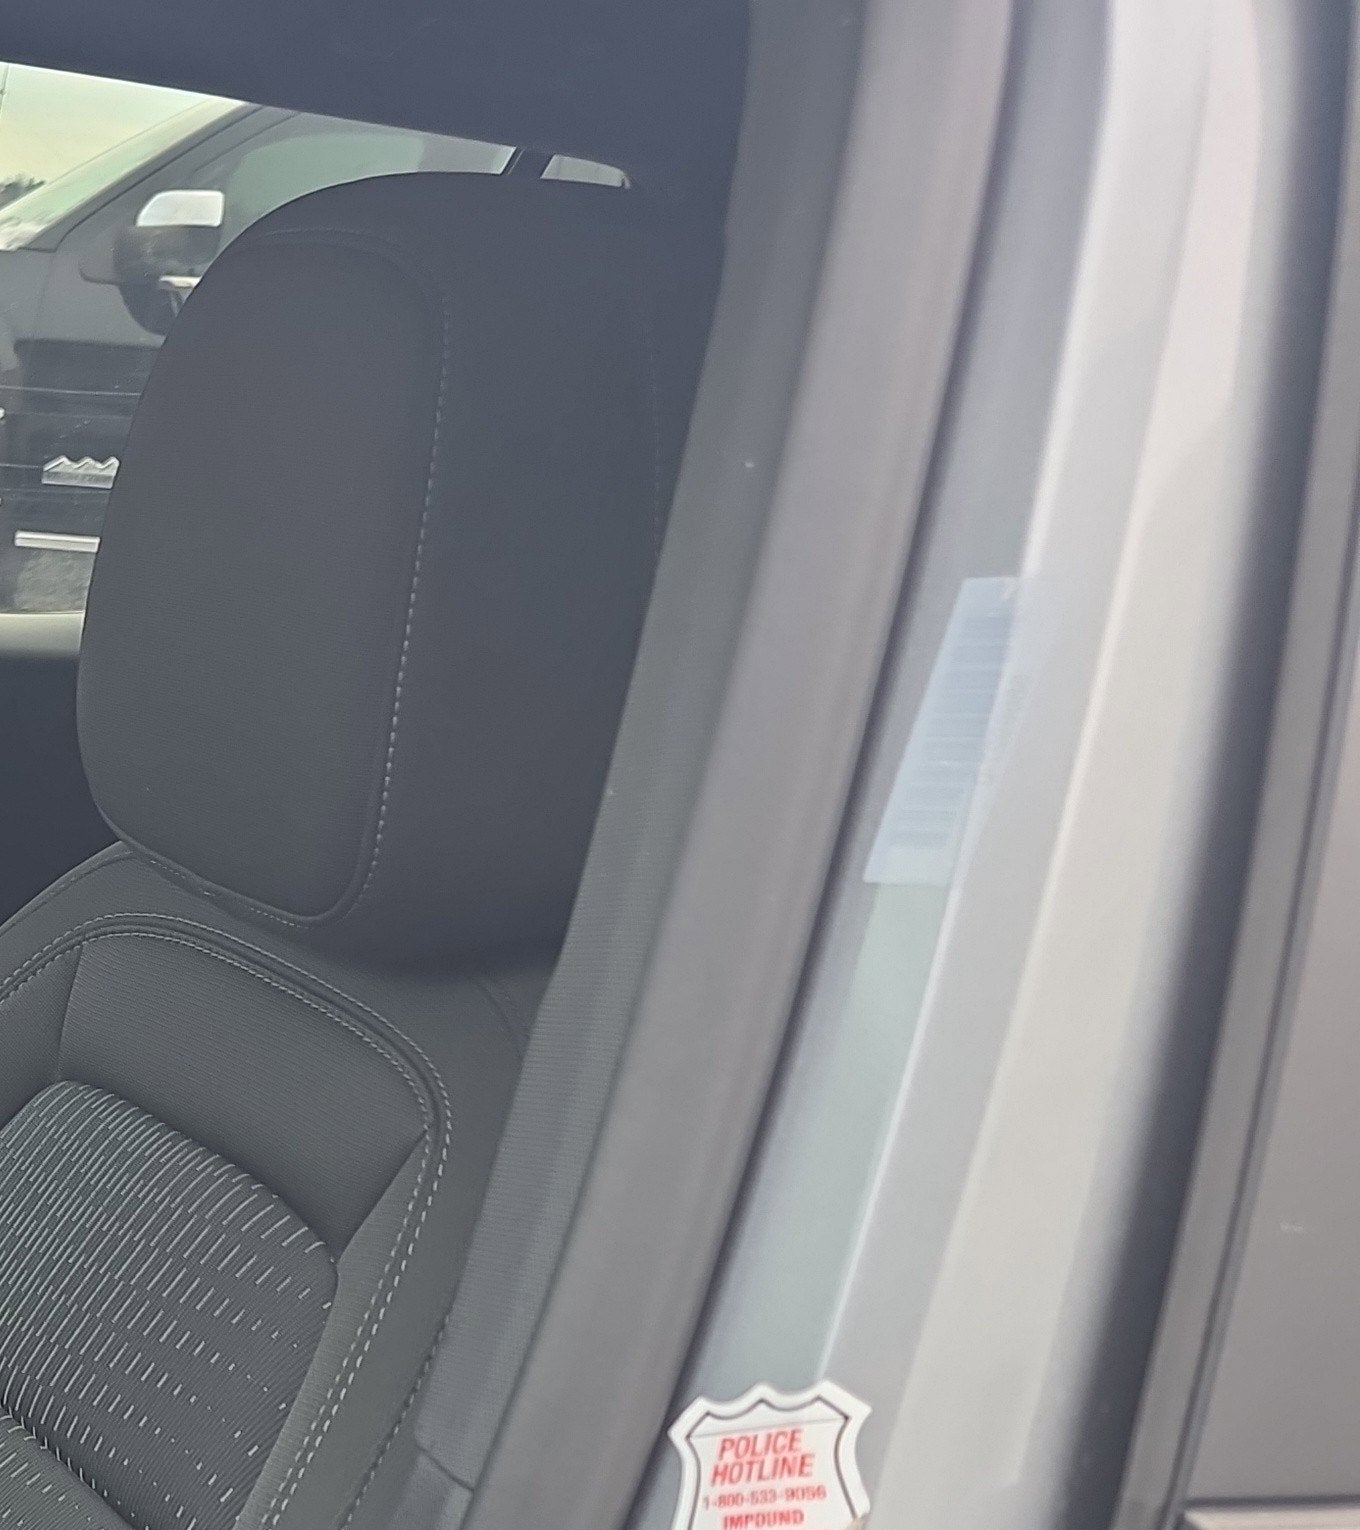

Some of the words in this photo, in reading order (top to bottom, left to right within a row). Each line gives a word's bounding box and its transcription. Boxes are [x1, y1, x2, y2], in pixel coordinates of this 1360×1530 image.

[717, 1428, 803, 1462] POLICE
[710, 1453, 814, 1487] HOTLINE
[723, 1509, 805, 1530] IMPOUND
